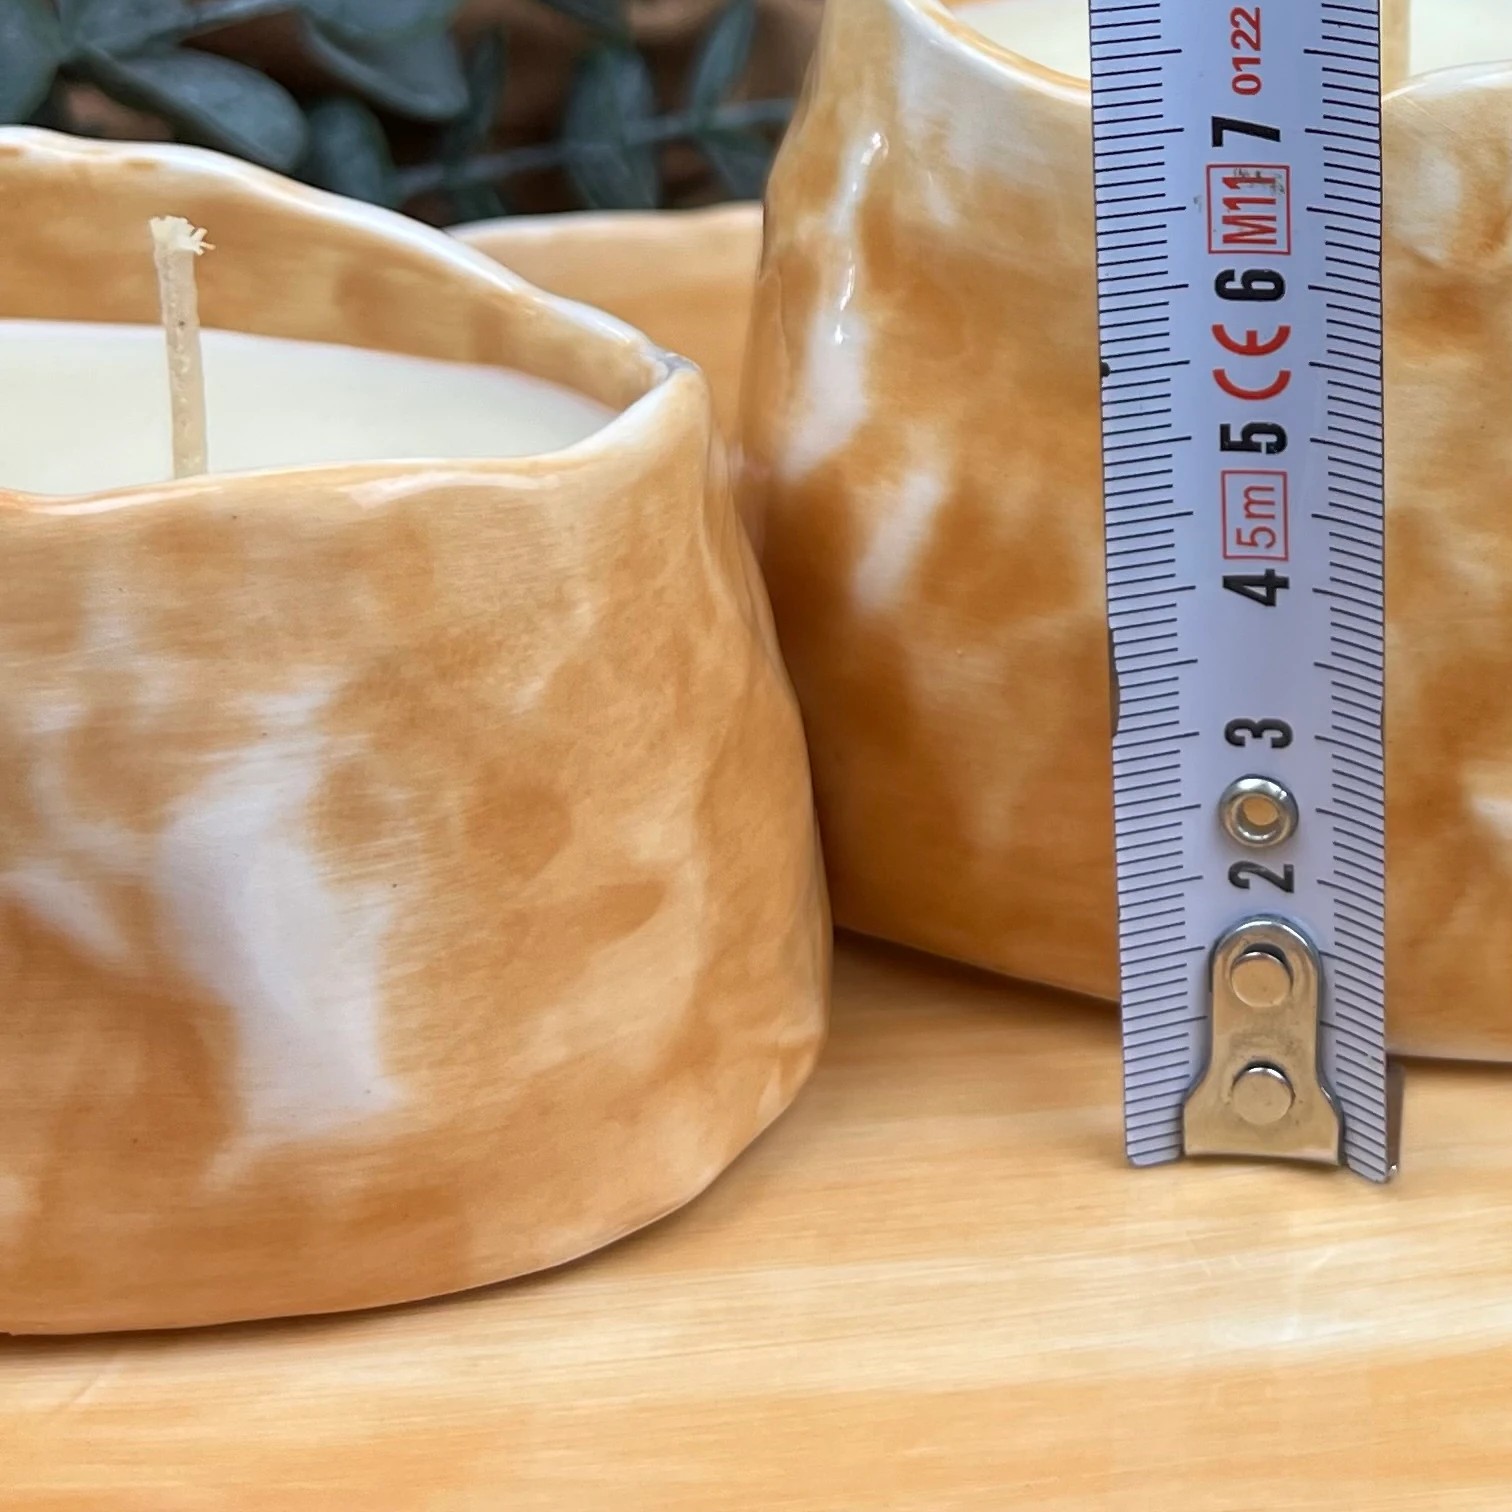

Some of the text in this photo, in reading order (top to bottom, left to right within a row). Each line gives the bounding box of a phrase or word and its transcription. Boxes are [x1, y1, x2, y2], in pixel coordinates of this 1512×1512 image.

[1230, 7, 1262, 95] 0122
[1211, 116, 1281, 147] 7
[1215, 268, 1286, 301] 6
[1212, 324, 1291, 400] CE
[1220, 422, 1288, 454] 5
[1236, 485, 1277, 549] 5m
[1223, 568, 1290, 607] 4
[1225, 717, 1293, 748] 3
[1228, 860, 1294, 893] 2
